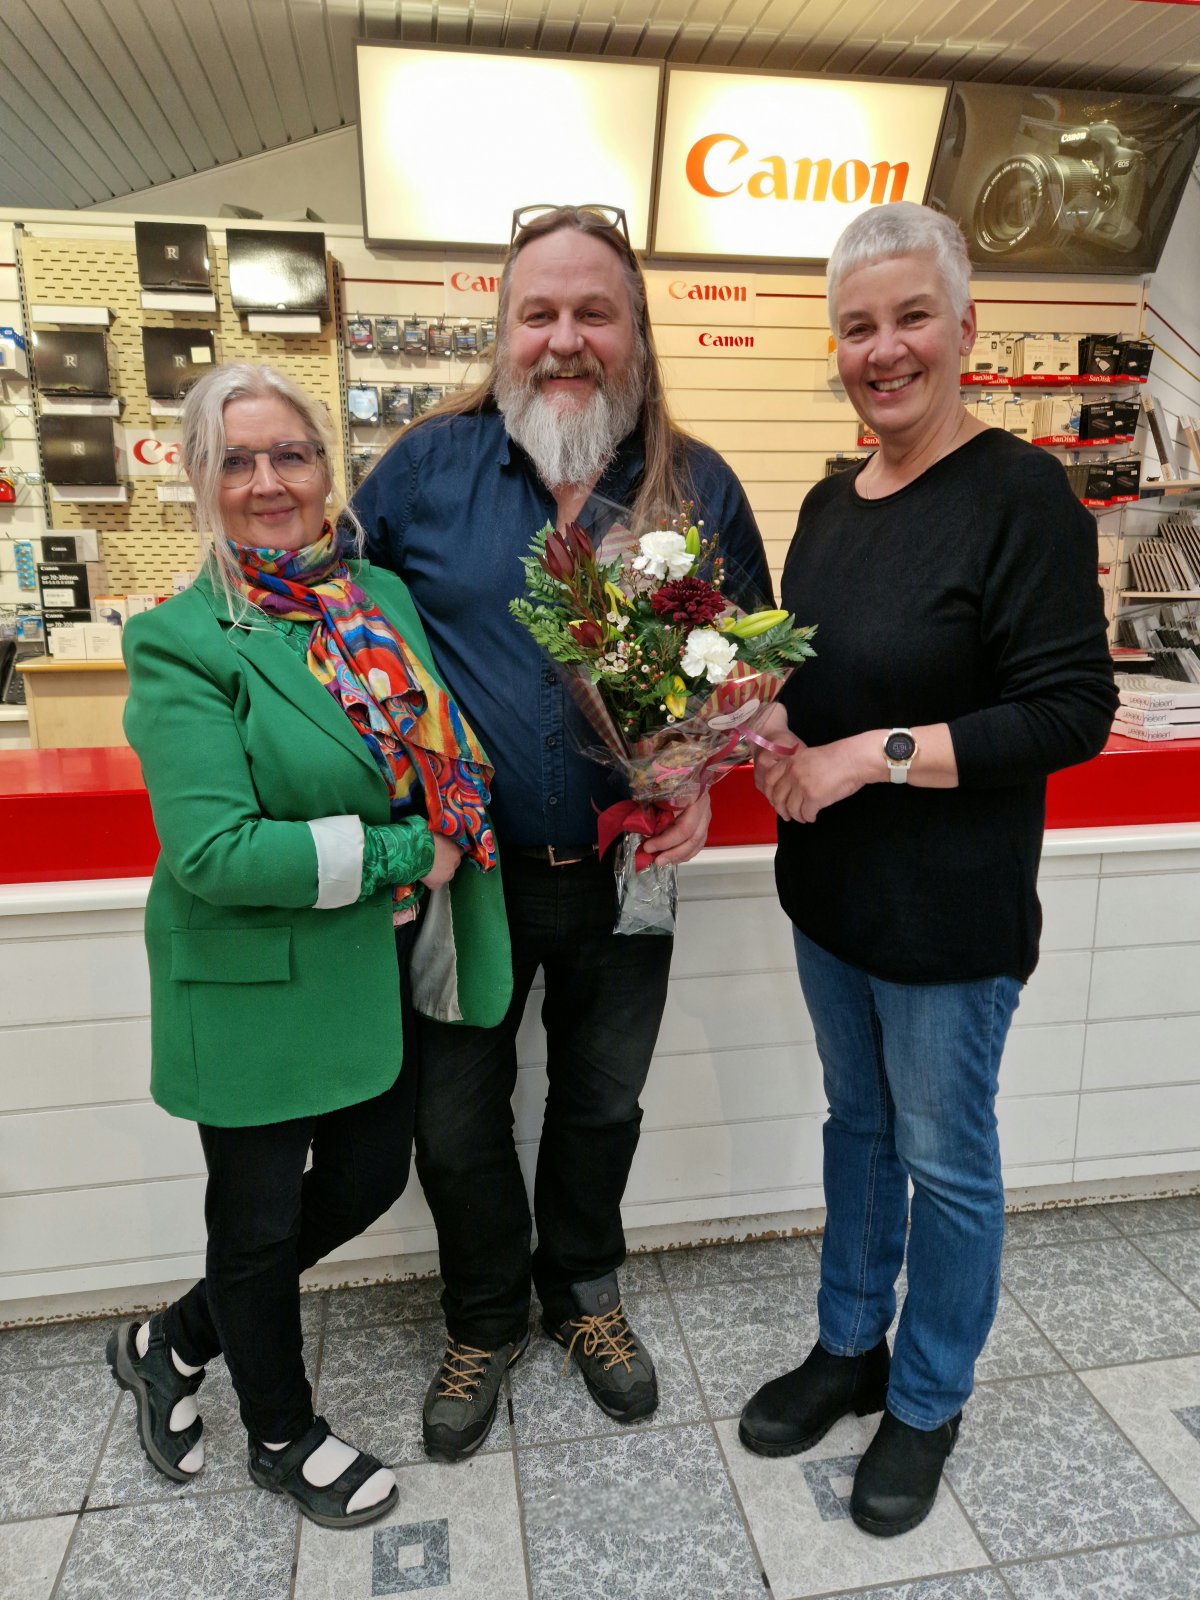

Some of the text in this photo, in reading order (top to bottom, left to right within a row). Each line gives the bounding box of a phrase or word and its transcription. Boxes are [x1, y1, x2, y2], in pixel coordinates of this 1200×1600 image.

[1061, 132, 1087, 143] Canon
[686, 133, 909, 204] Canon
[1117, 160, 1130, 168] EOS
[167, 247, 178, 259] R
[451, 271, 501, 293] Can
[668, 281, 747, 301] Canon
[699, 333, 755, 347] Canon
[65, 355, 77, 367] R
[175, 356, 186, 367] R
[1089, 375, 1111, 383] SanDisk
[1052, 435, 1076, 443] SanDisk
[73, 443, 86, 455] R
